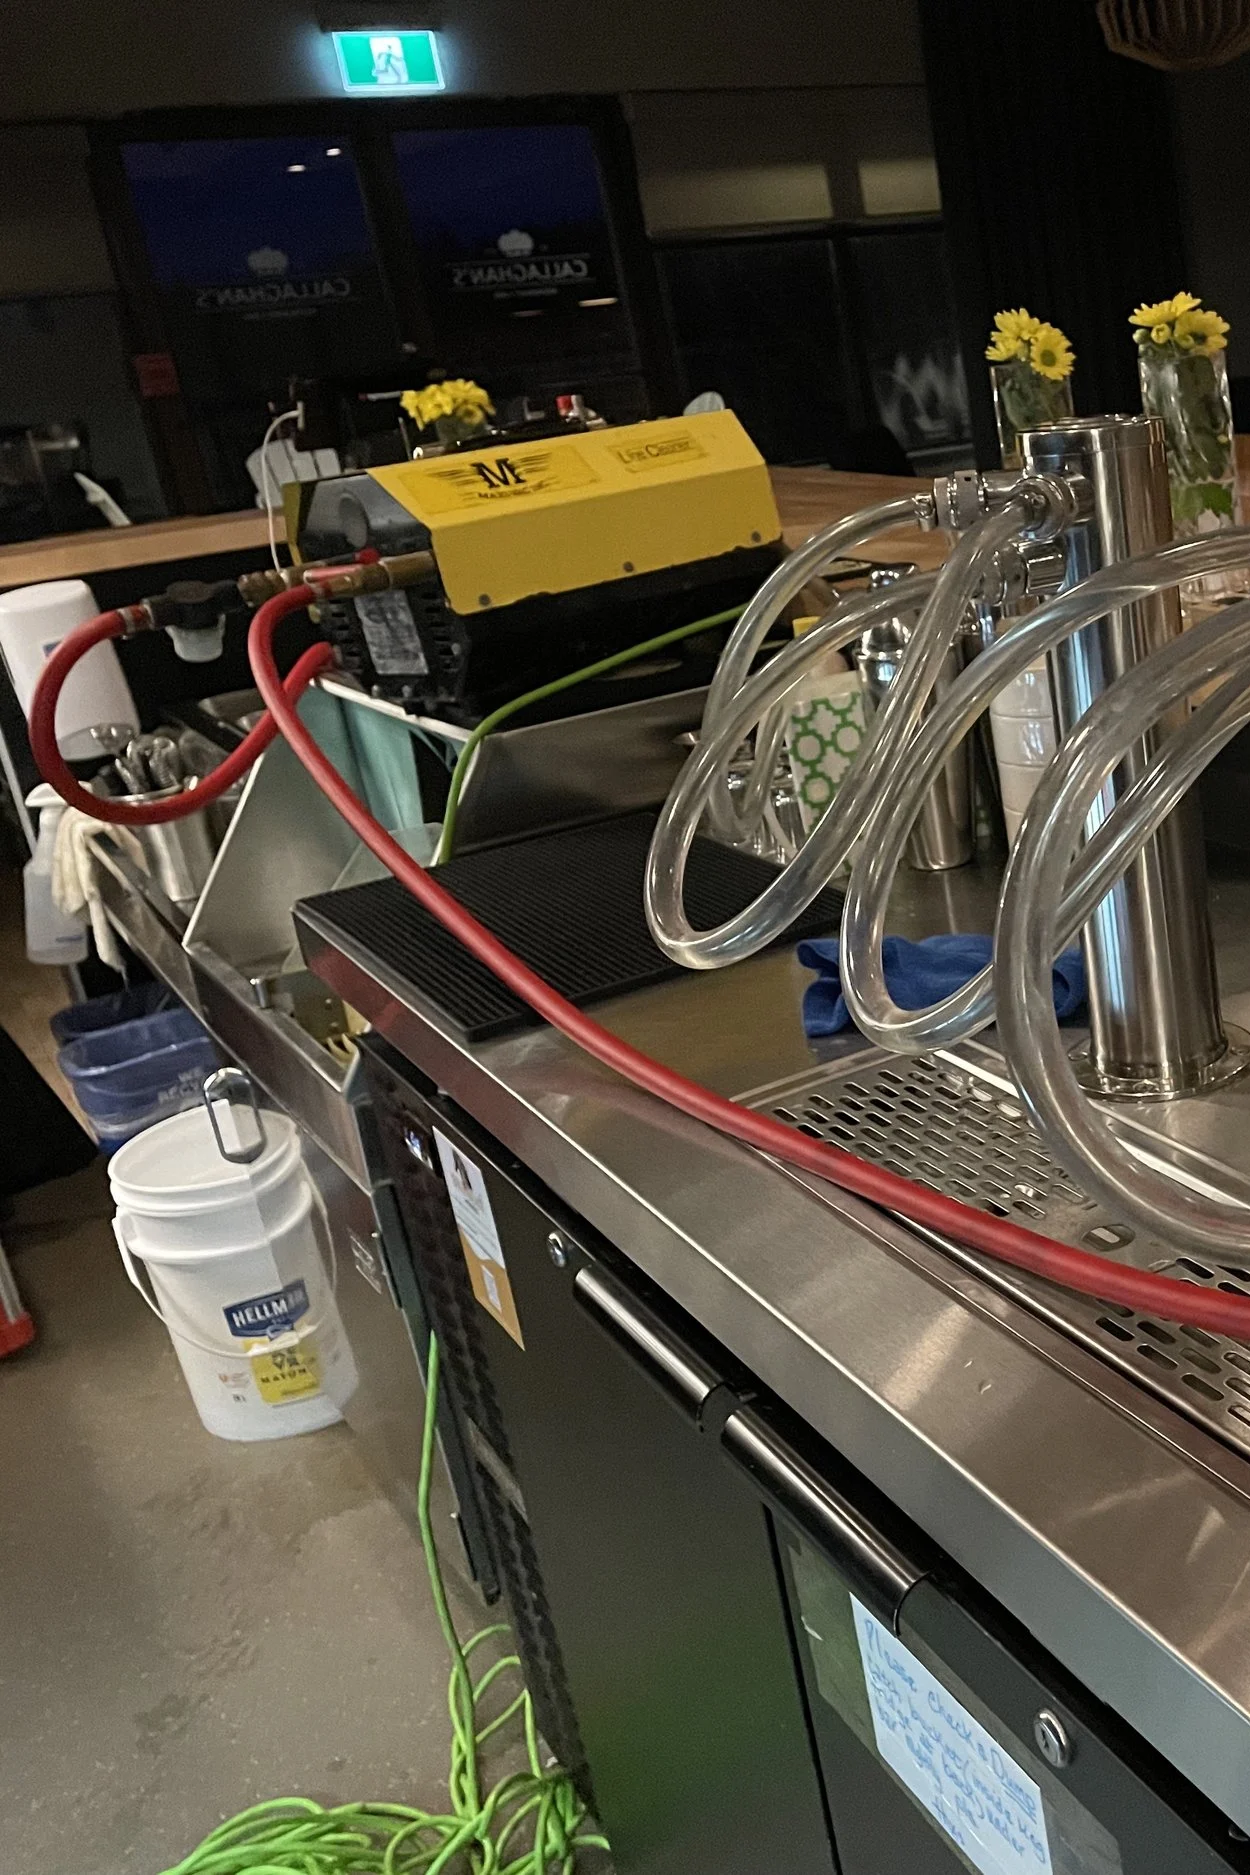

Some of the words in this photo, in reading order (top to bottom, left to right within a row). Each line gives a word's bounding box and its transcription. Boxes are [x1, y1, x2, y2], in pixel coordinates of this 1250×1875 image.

[471, 458, 527, 489] M
[865, 1620, 917, 1690] Please
[928, 1690, 974, 1748] Check
